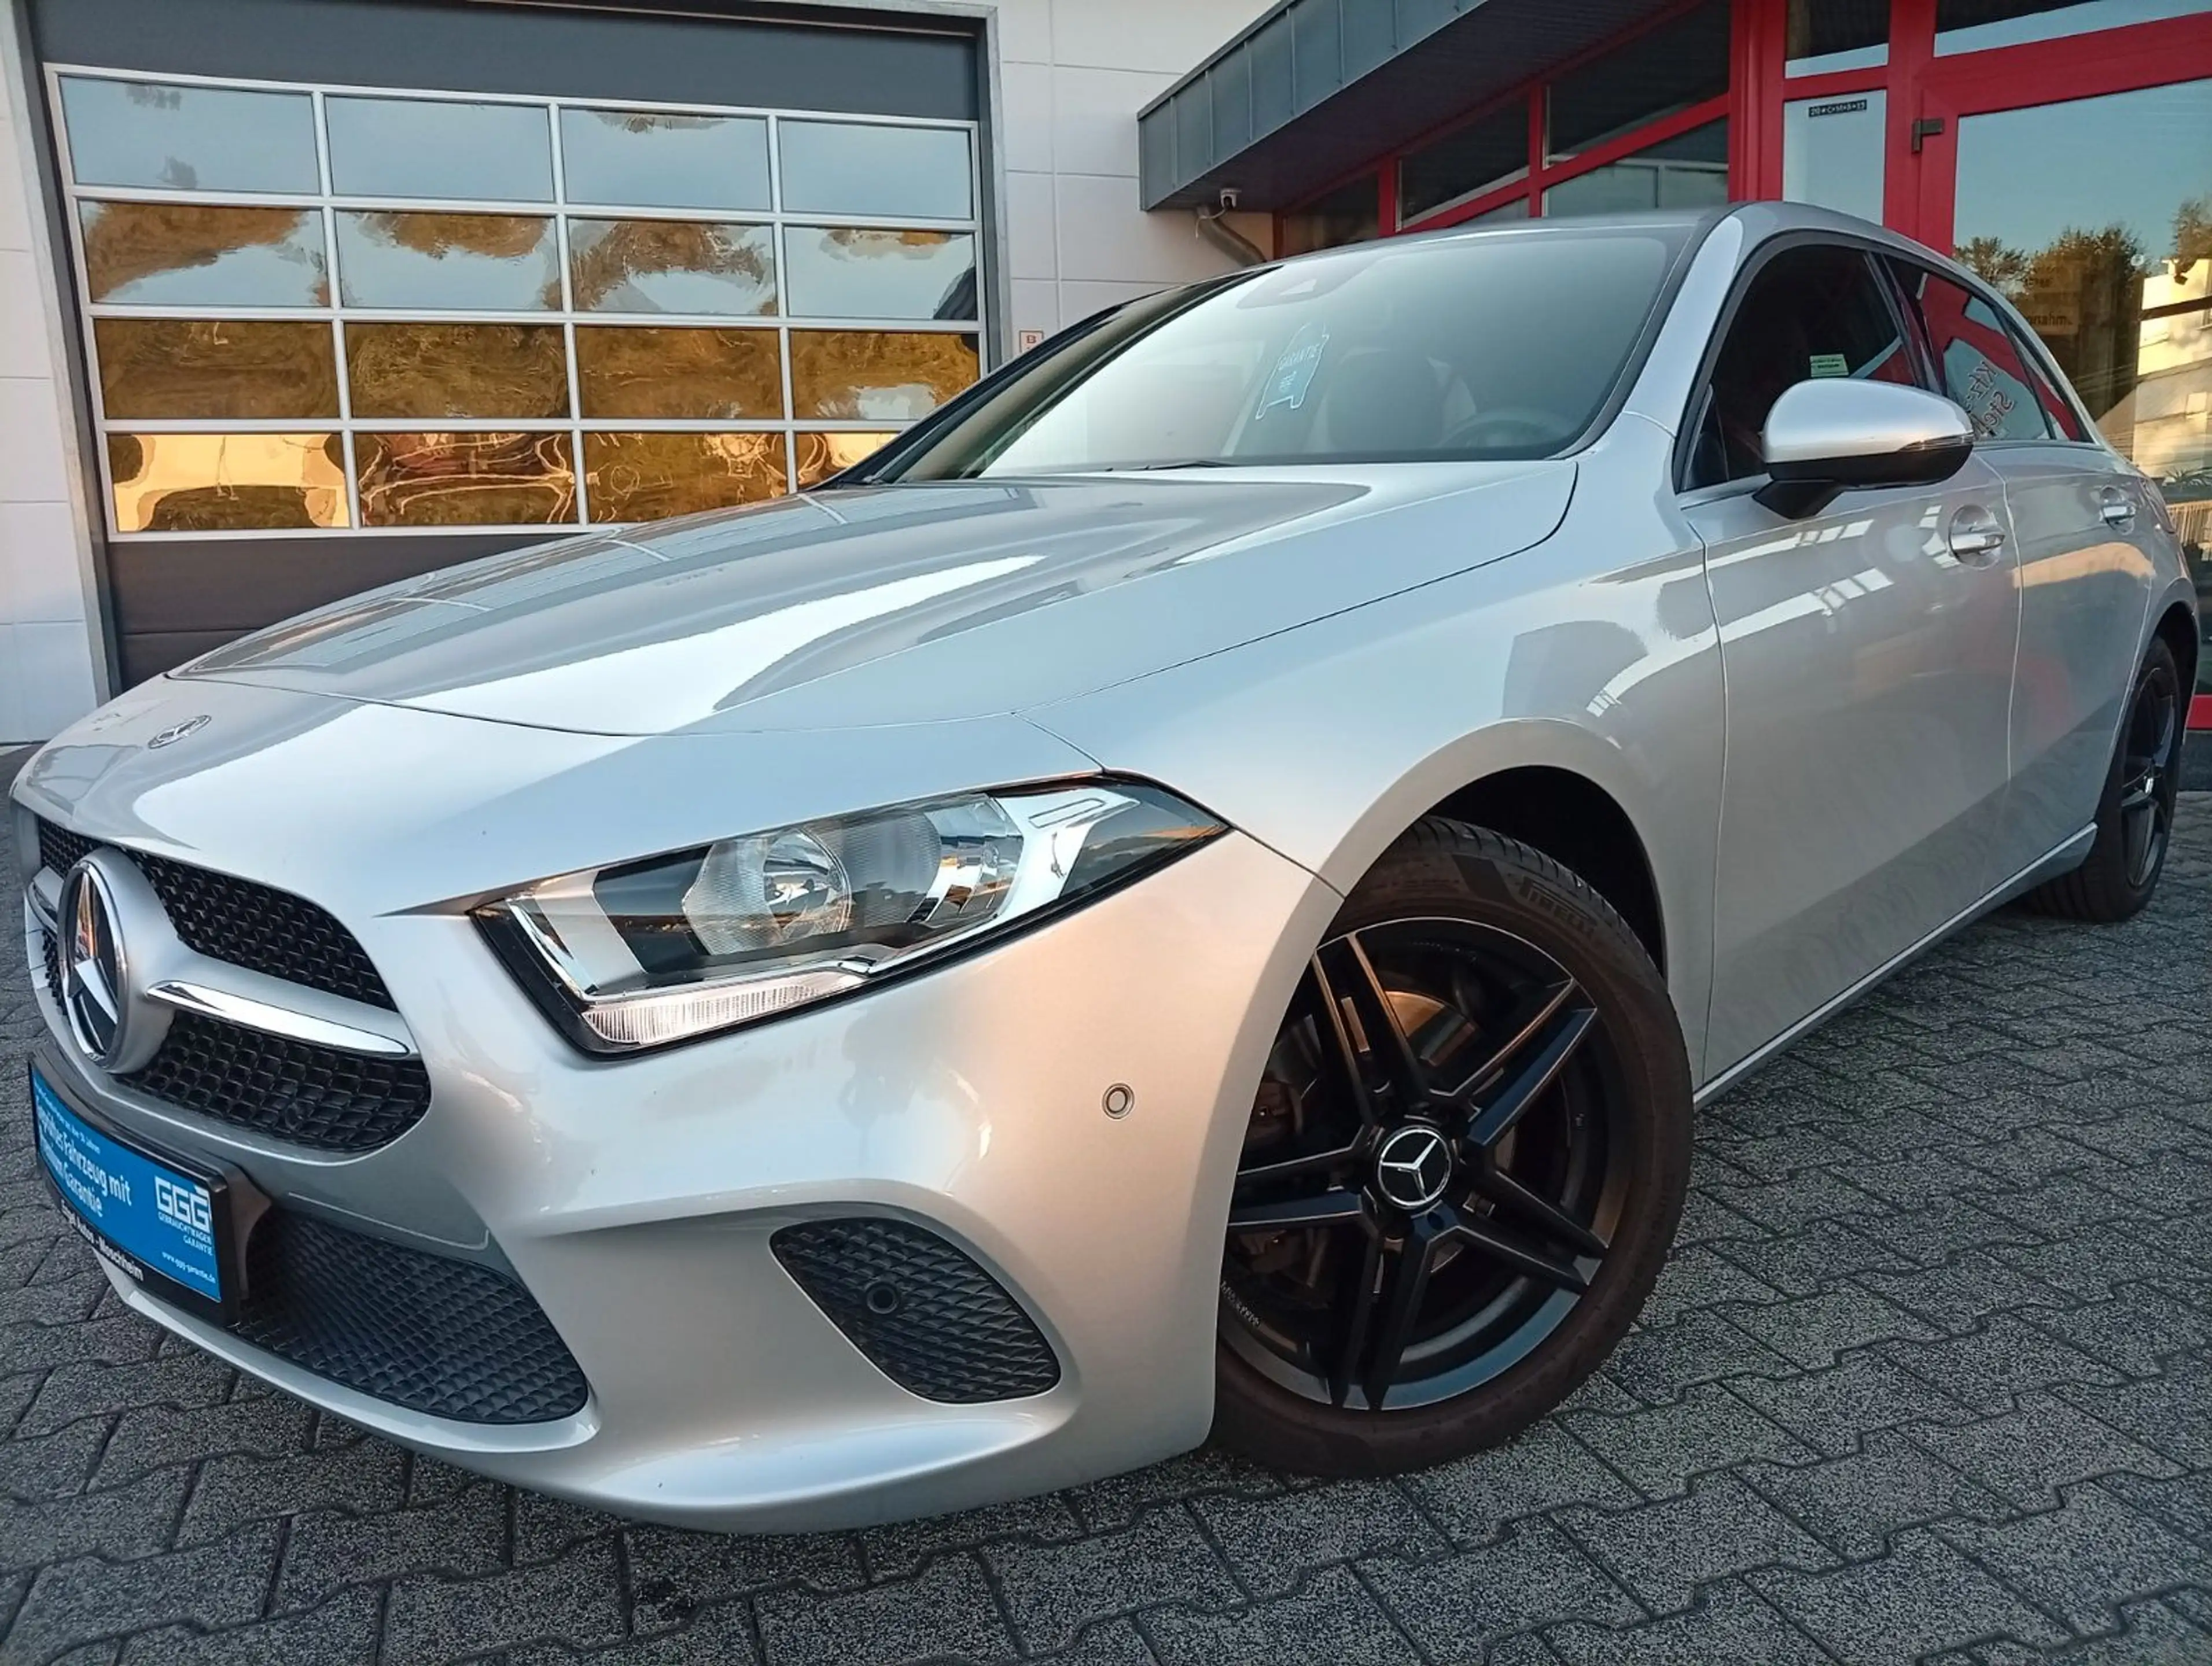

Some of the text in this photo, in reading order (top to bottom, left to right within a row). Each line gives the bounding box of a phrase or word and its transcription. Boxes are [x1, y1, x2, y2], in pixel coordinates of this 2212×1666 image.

[62, 1131, 108, 1197] Fahrzeug
[109, 1174, 132, 1206] mit
[63, 1160, 104, 1217] Garantie
[154, 1175, 211, 1233] GGG
[158, 1211, 212, 1245] GEBRAUCHTWAGEN
[183, 1235, 213, 1256] GARANTIE
